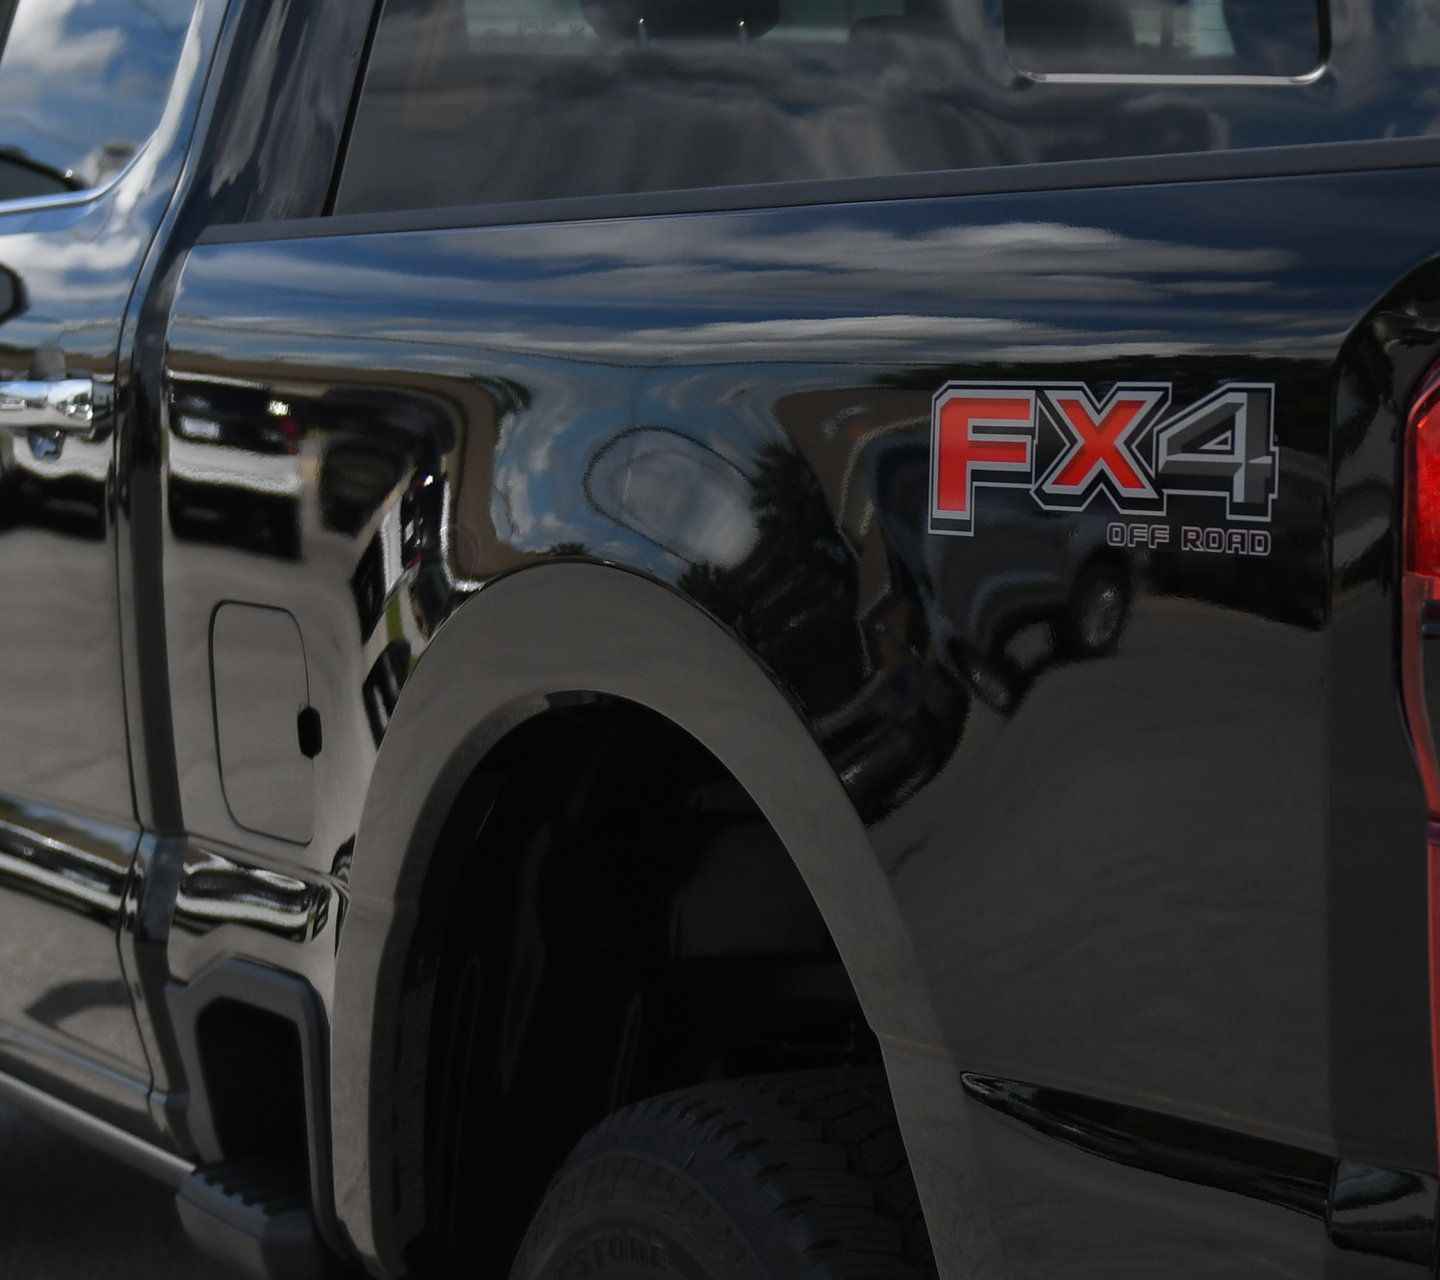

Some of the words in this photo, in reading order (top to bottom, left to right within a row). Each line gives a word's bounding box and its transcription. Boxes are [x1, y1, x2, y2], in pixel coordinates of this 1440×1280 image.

[928, 380, 1279, 536] FX4
[1107, 522, 1170, 549] OFF
[1181, 525, 1272, 556] ROAD
